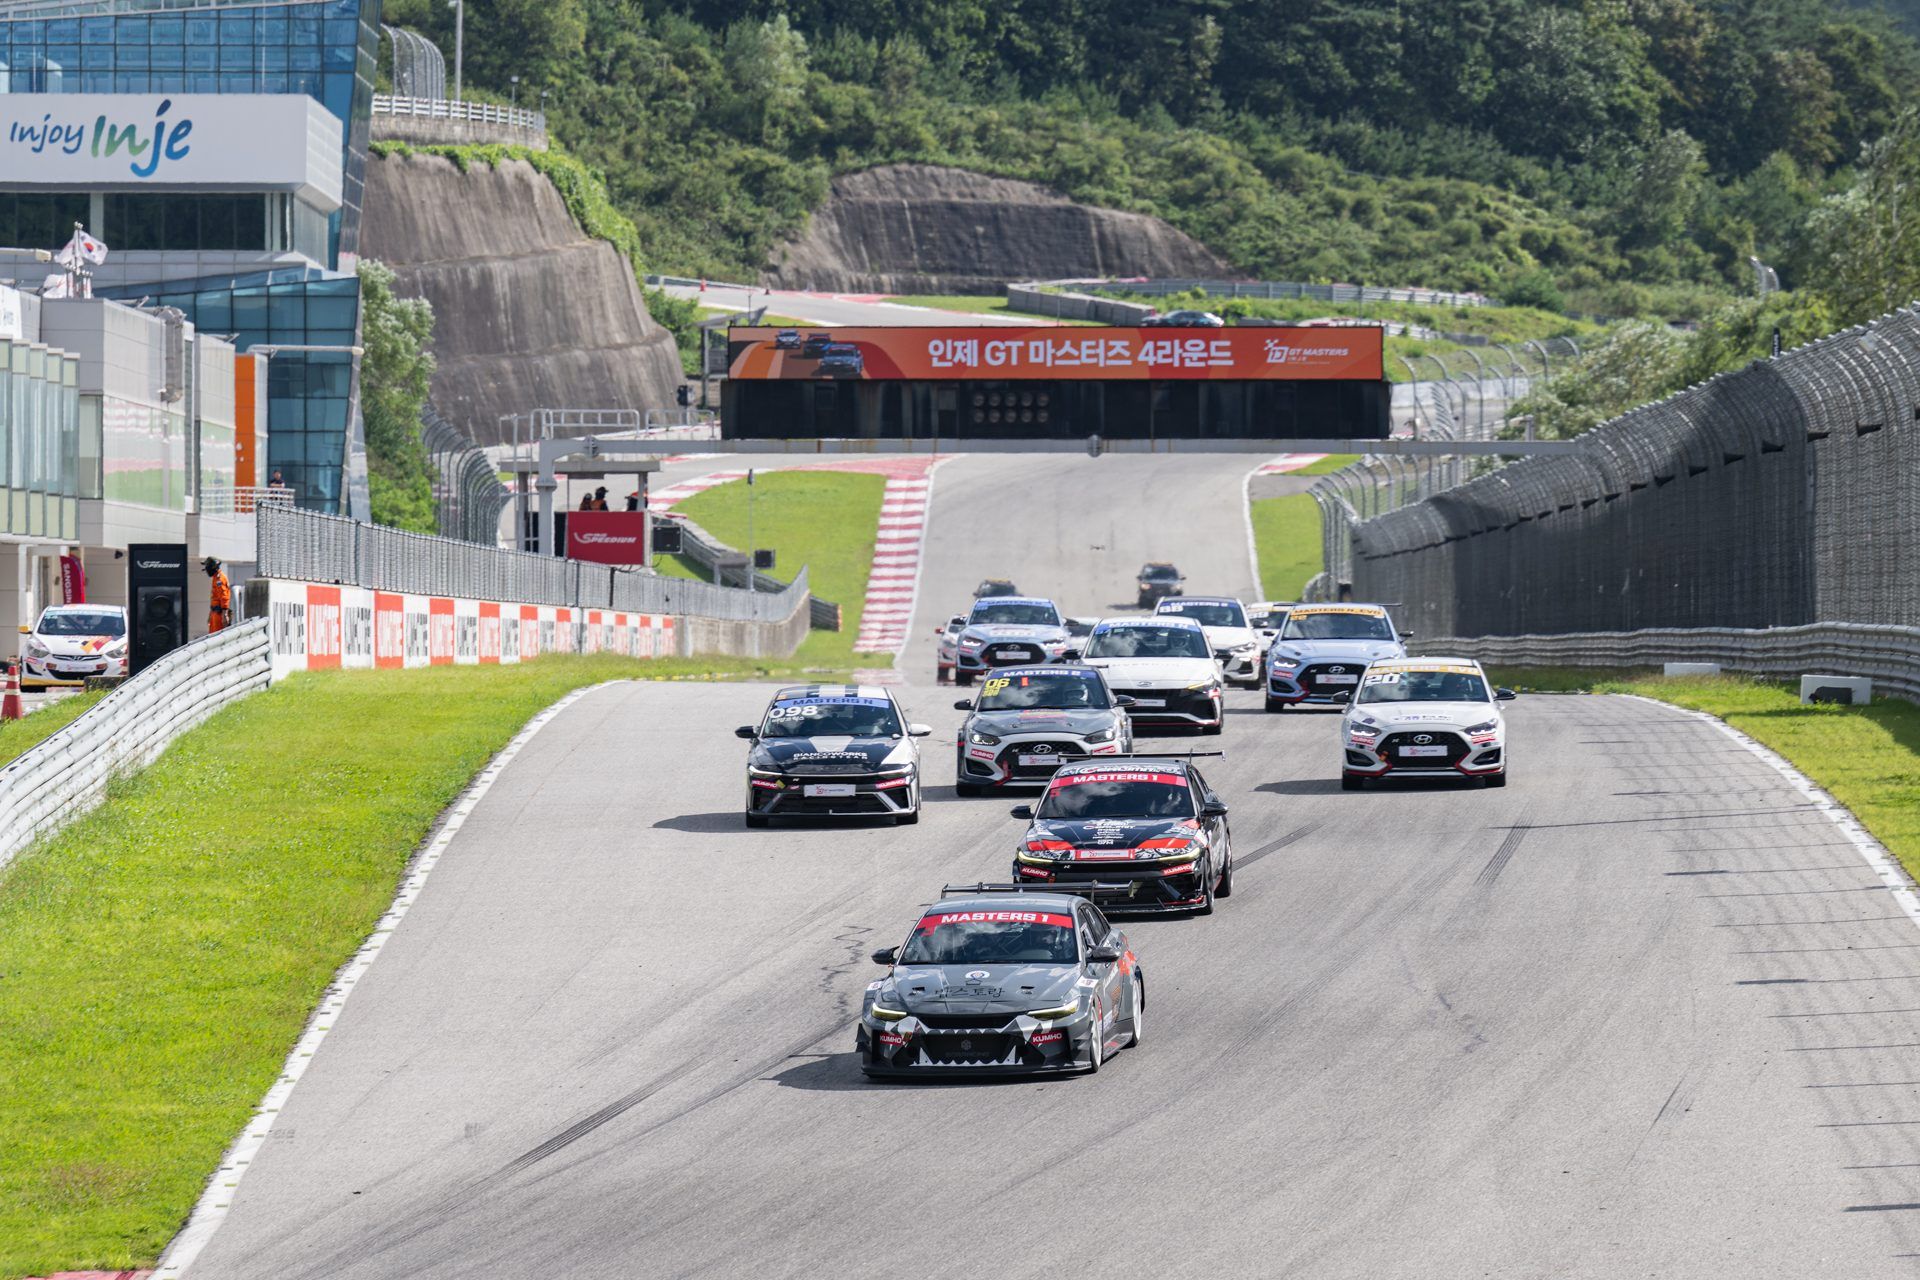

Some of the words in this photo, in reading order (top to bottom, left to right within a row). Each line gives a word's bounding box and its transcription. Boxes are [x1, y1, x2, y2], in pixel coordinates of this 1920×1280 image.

[9, 113, 84, 154] Injoy
[90, 98, 193, 177] Inje
[927, 339, 978, 367] 인제
[984, 340, 1025, 367] GT
[1030, 339, 1132, 367] 마스터즈
[1138, 339, 1234, 367] 4라운드
[1289, 348, 1302, 356] GT
[1303, 348, 1349, 356] MASTERS
[1003, 669, 1069, 677] MASTERS
[985, 678, 1011, 688] 06
[769, 705, 818, 719] 098
[971, 750, 994, 759] KUMHO
[1073, 773, 1149, 783] MASTERS
[1021, 867, 1049, 876] KUMHO
[1164, 864, 1192, 875] KUMHO
[941, 912, 1036, 923] MASTERS
[1042, 913, 1049, 922] 1
[879, 1035, 903, 1044] KUMHO
[1032, 1032, 1063, 1043] KUMHO
